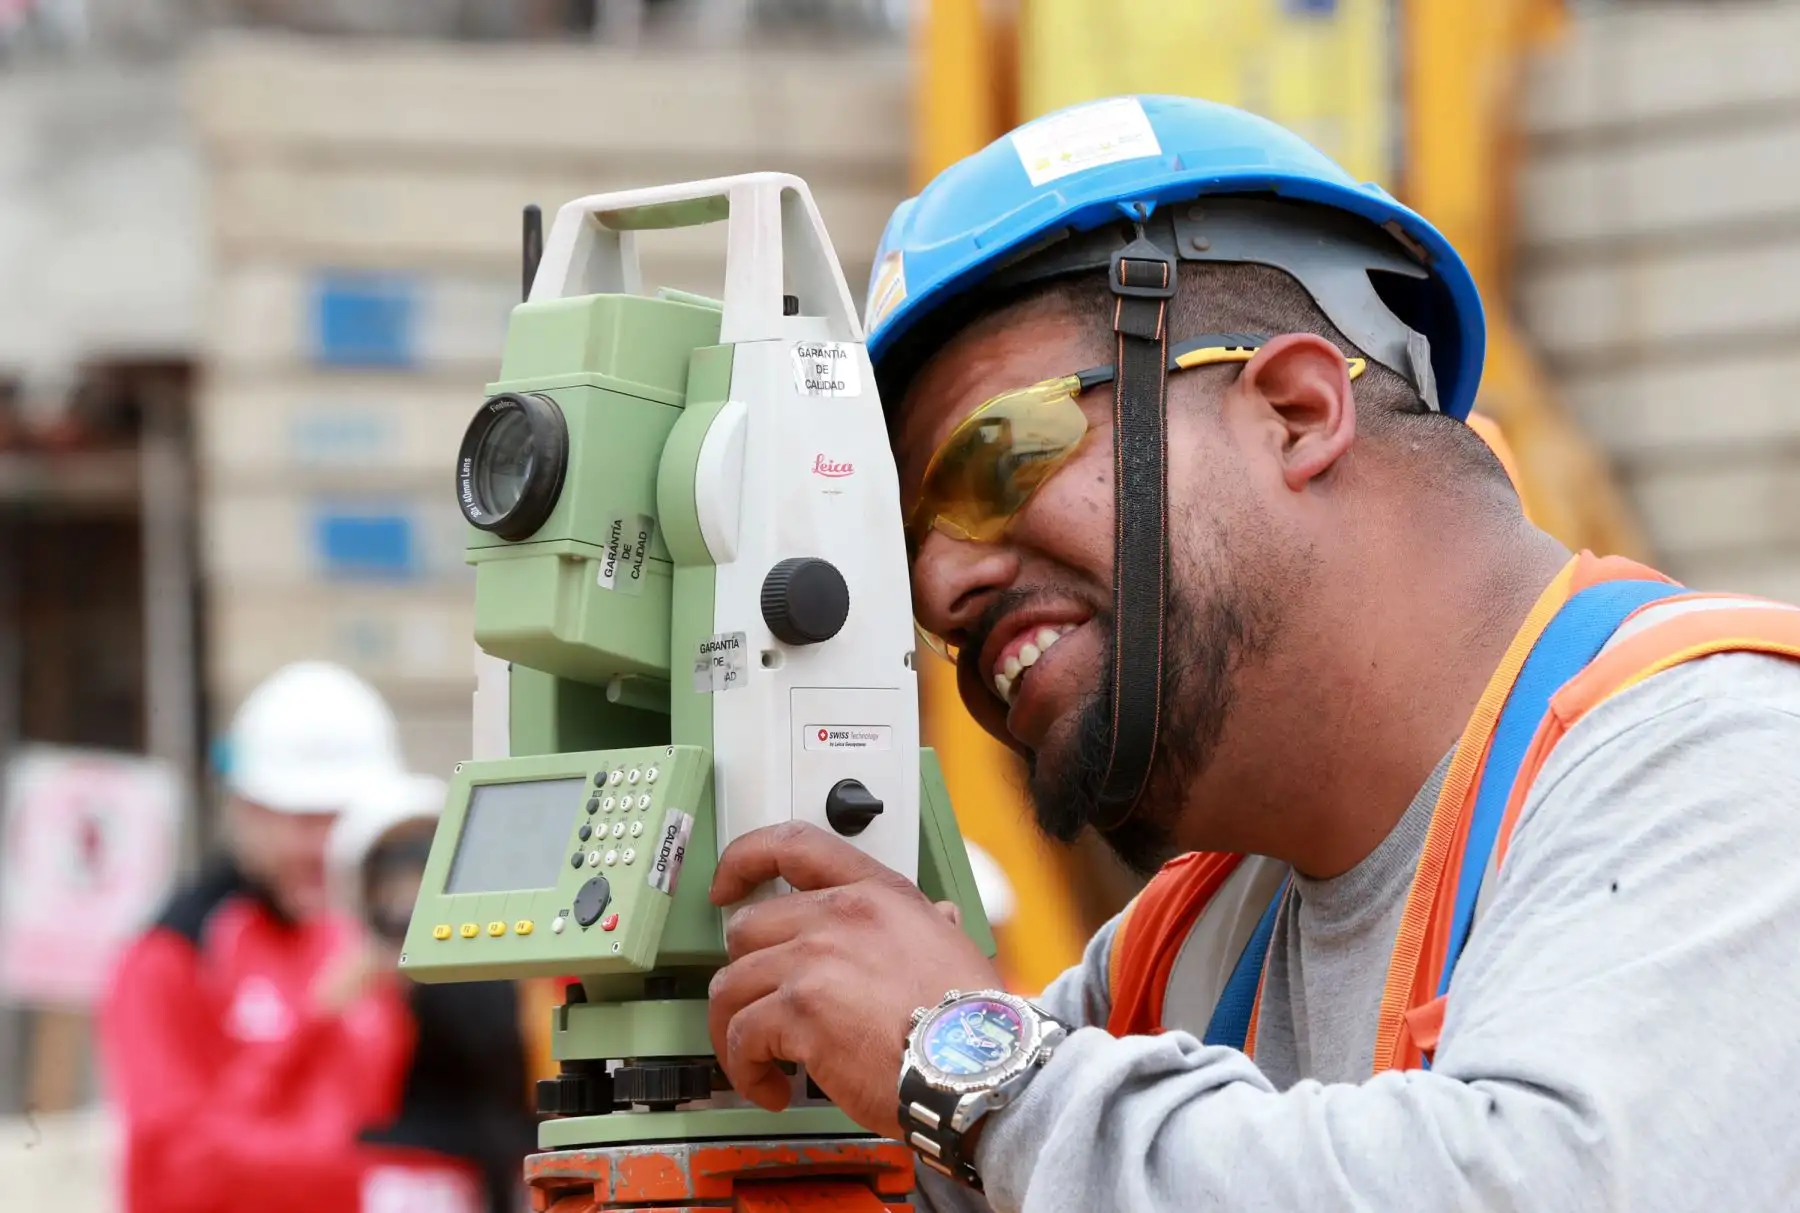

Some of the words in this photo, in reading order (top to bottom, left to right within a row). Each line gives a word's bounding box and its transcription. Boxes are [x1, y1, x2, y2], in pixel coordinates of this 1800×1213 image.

[816, 364, 829, 375] DE
[805, 379, 845, 390] CALIDAD
[461, 457, 471, 477] Lens
[812, 453, 854, 477] Leica
[463, 479, 472, 503] 40mm
[604, 519, 622, 578] GARANTÍA
[621, 544, 632, 560] DE
[631, 531, 647, 580] CALIDAD
[713, 656, 724, 667] DE
[829, 731, 849, 739] SWISS
[656, 825, 677, 872] CALIDAD
[674, 846, 685, 863] DE
